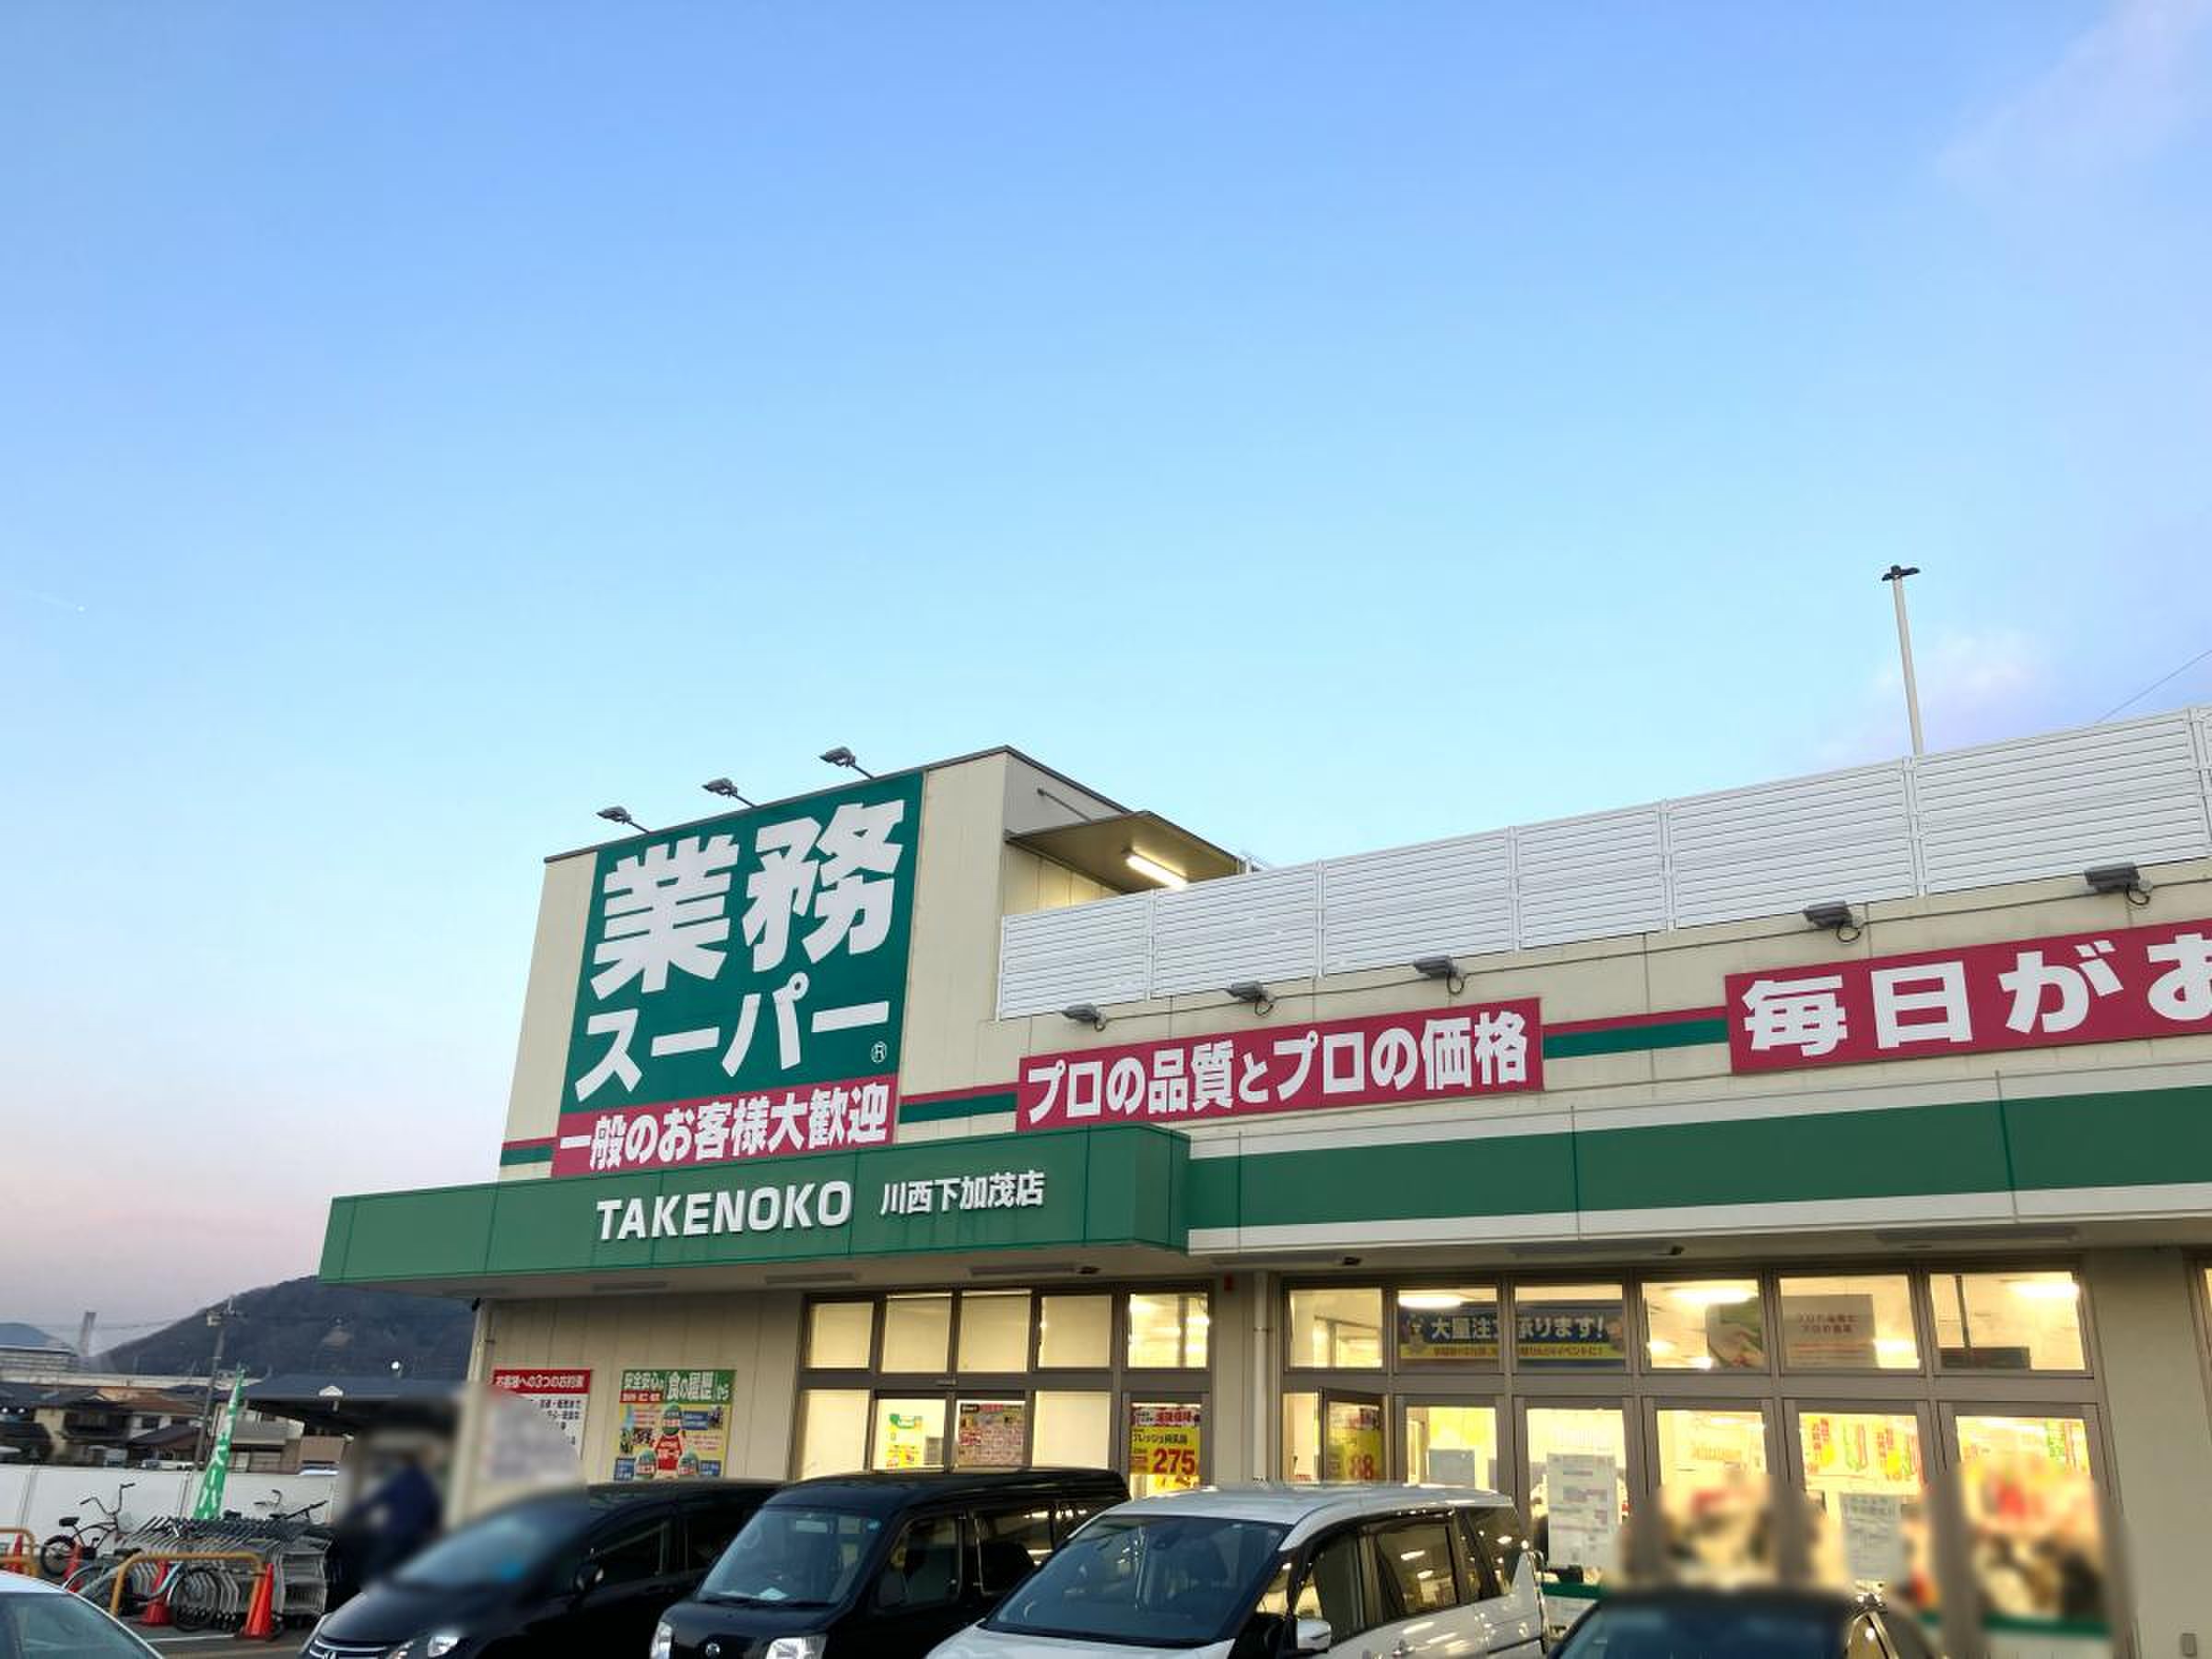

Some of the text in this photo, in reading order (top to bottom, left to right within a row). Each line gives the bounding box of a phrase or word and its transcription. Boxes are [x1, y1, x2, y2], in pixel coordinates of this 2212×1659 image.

[591, 799, 905, 1001] 業務
[574, 972, 890, 1102] スーパー
[1027, 1010, 1527, 1124] プロの品質とプロの価格
[559, 1083, 890, 1170] 一般のお客様大歓迎
[596, 1179, 854, 1242] TAKENOKO
[880, 1169, 1046, 1217] 川西下加茂店
[1152, 1447, 1196, 1476] 275
